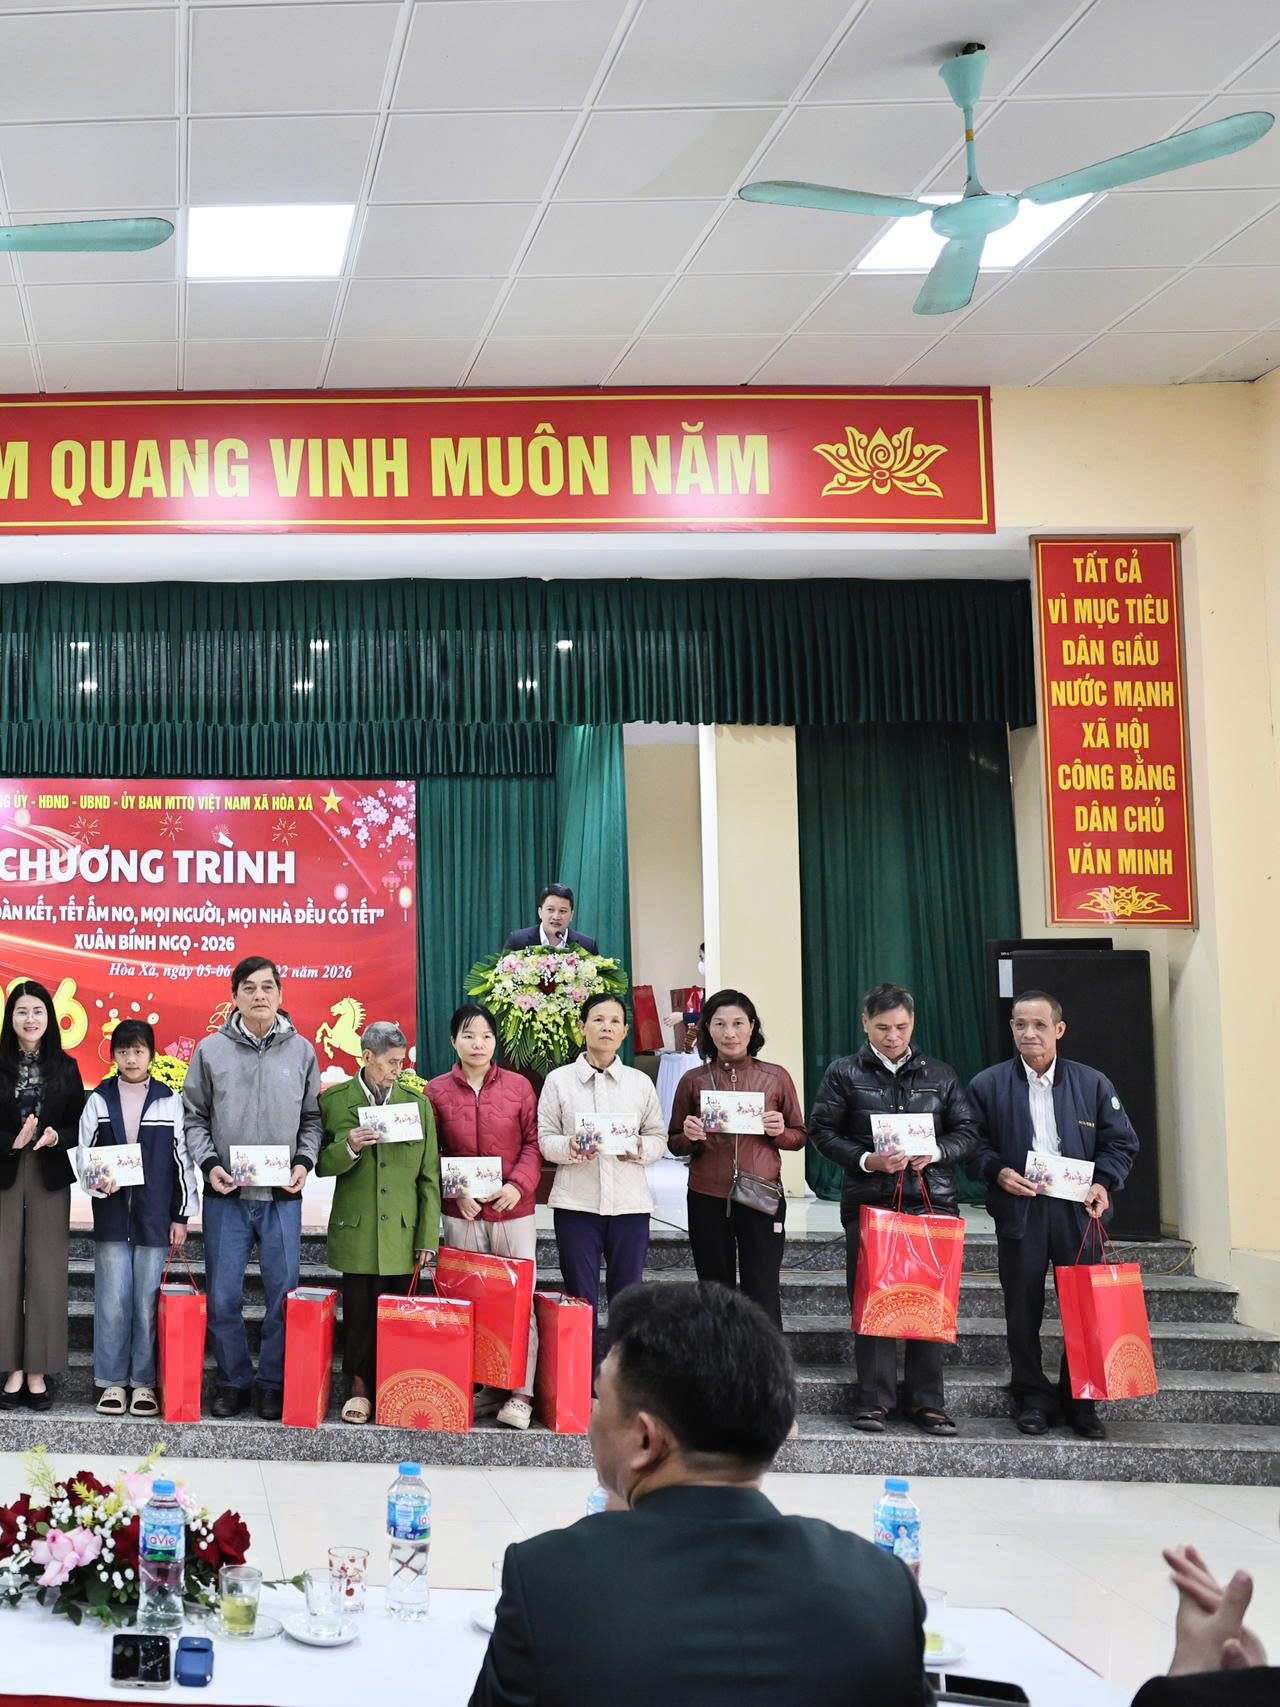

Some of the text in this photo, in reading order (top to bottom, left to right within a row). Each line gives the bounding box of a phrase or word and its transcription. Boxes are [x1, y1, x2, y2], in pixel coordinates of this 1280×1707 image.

[50, 437, 250, 507] QUANG
[269, 437, 409, 499] VINH
[429, 424, 610, 498] MUÔN
[630, 421, 770, 496] NĂM
[1072, 548, 1142, 583] TẤT CẢ
[1048, 592, 1169, 629] VÌ MỤC TIÊU
[1062, 632, 1158, 665] DÂN GIẦU
[1051, 674, 1174, 712] NƯỚC MẠNH
[1082, 718, 1149, 753] XÃ HỘI
[1058, 754, 1176, 791] CÔNG BẰNG
[39, 795, 69, 809] HĐND
[80, 795, 110, 809] UBND
[121, 790, 135, 809] ỦY
[139, 795, 162, 810] BAN
[165, 795, 194, 811] MTTQ
[198, 793, 220, 813] VIỆT
[224, 796, 251, 810] NAM
[272, 793, 294, 811] HÒA
[1075, 796, 1165, 832] DÂN CHỦ
[172, 832, 295, 884] TRÌNH
[1068, 843, 1173, 875] VĂN MINH
[26, 894, 57, 924] KẾT,
[59, 895, 84, 921] TẾT
[86, 895, 109, 921] ẤM
[111, 906, 138, 924] NO,
[141, 907, 169, 928] MỌI
[172, 900, 225, 926] NGƯỜI,
[228, 908, 257, 929] MỌI
[259, 901, 292, 924] NHÀ
[294, 897, 326, 924] ĐỀU
[328, 901, 349, 924] CÓ
[74, 928, 117, 950] XUÂN
[119, 928, 156, 951] BÍNH
[159, 935, 191, 956] NGỌ
[201, 936, 235, 951] 2026
[322, 965, 352, 978] 2026
